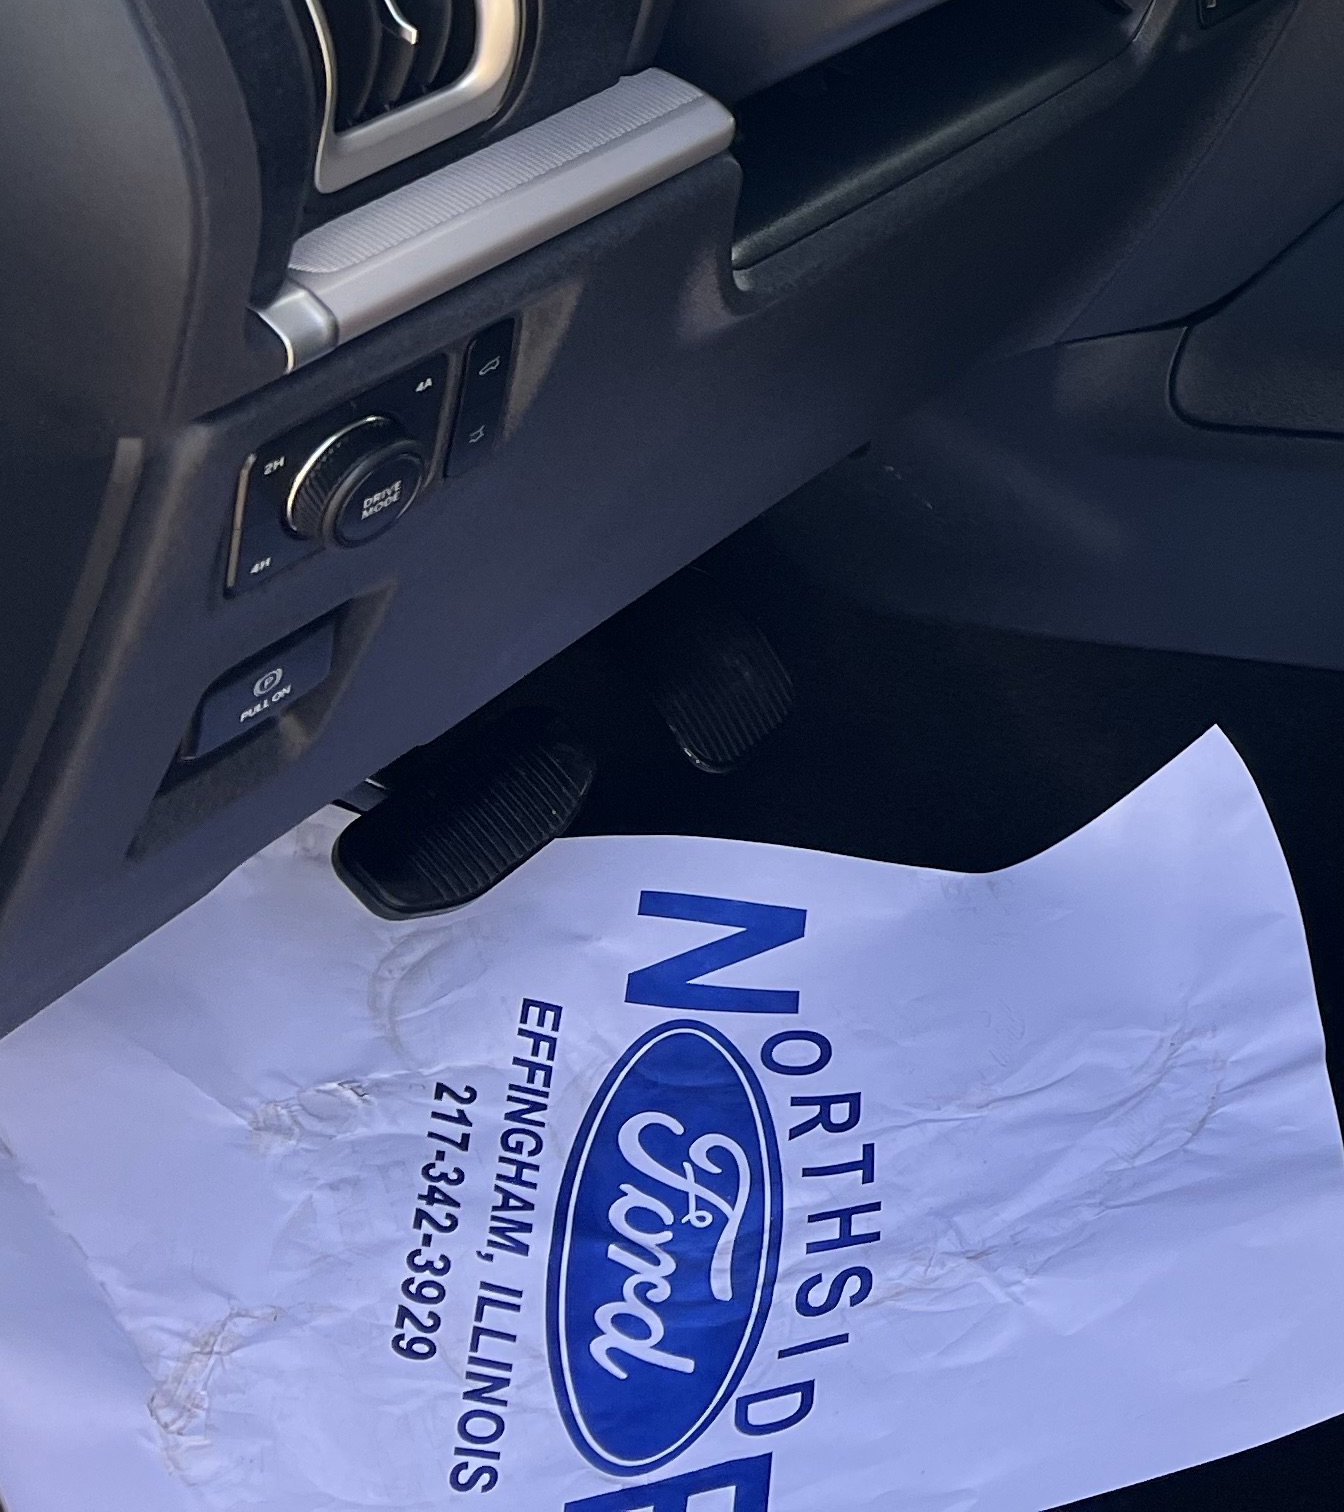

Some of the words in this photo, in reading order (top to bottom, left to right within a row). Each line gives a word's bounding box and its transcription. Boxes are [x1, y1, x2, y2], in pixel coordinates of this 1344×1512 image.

[415, 378, 433, 392] 4A
[264, 456, 285, 476] 2H
[361, 491, 400, 520] MODE
[363, 480, 402, 509] DRIVE
[250, 557, 272, 574] 4H
[240, 699, 269, 723] PULL
[271, 684, 291, 702] ON
[476, 997, 563, 1263] EFFINGHAM,
[391, 1081, 478, 1361] 217-342-3929
[589, 1111, 751, 1380] Ford
[449, 1281, 523, 1493] ILLINOIS
